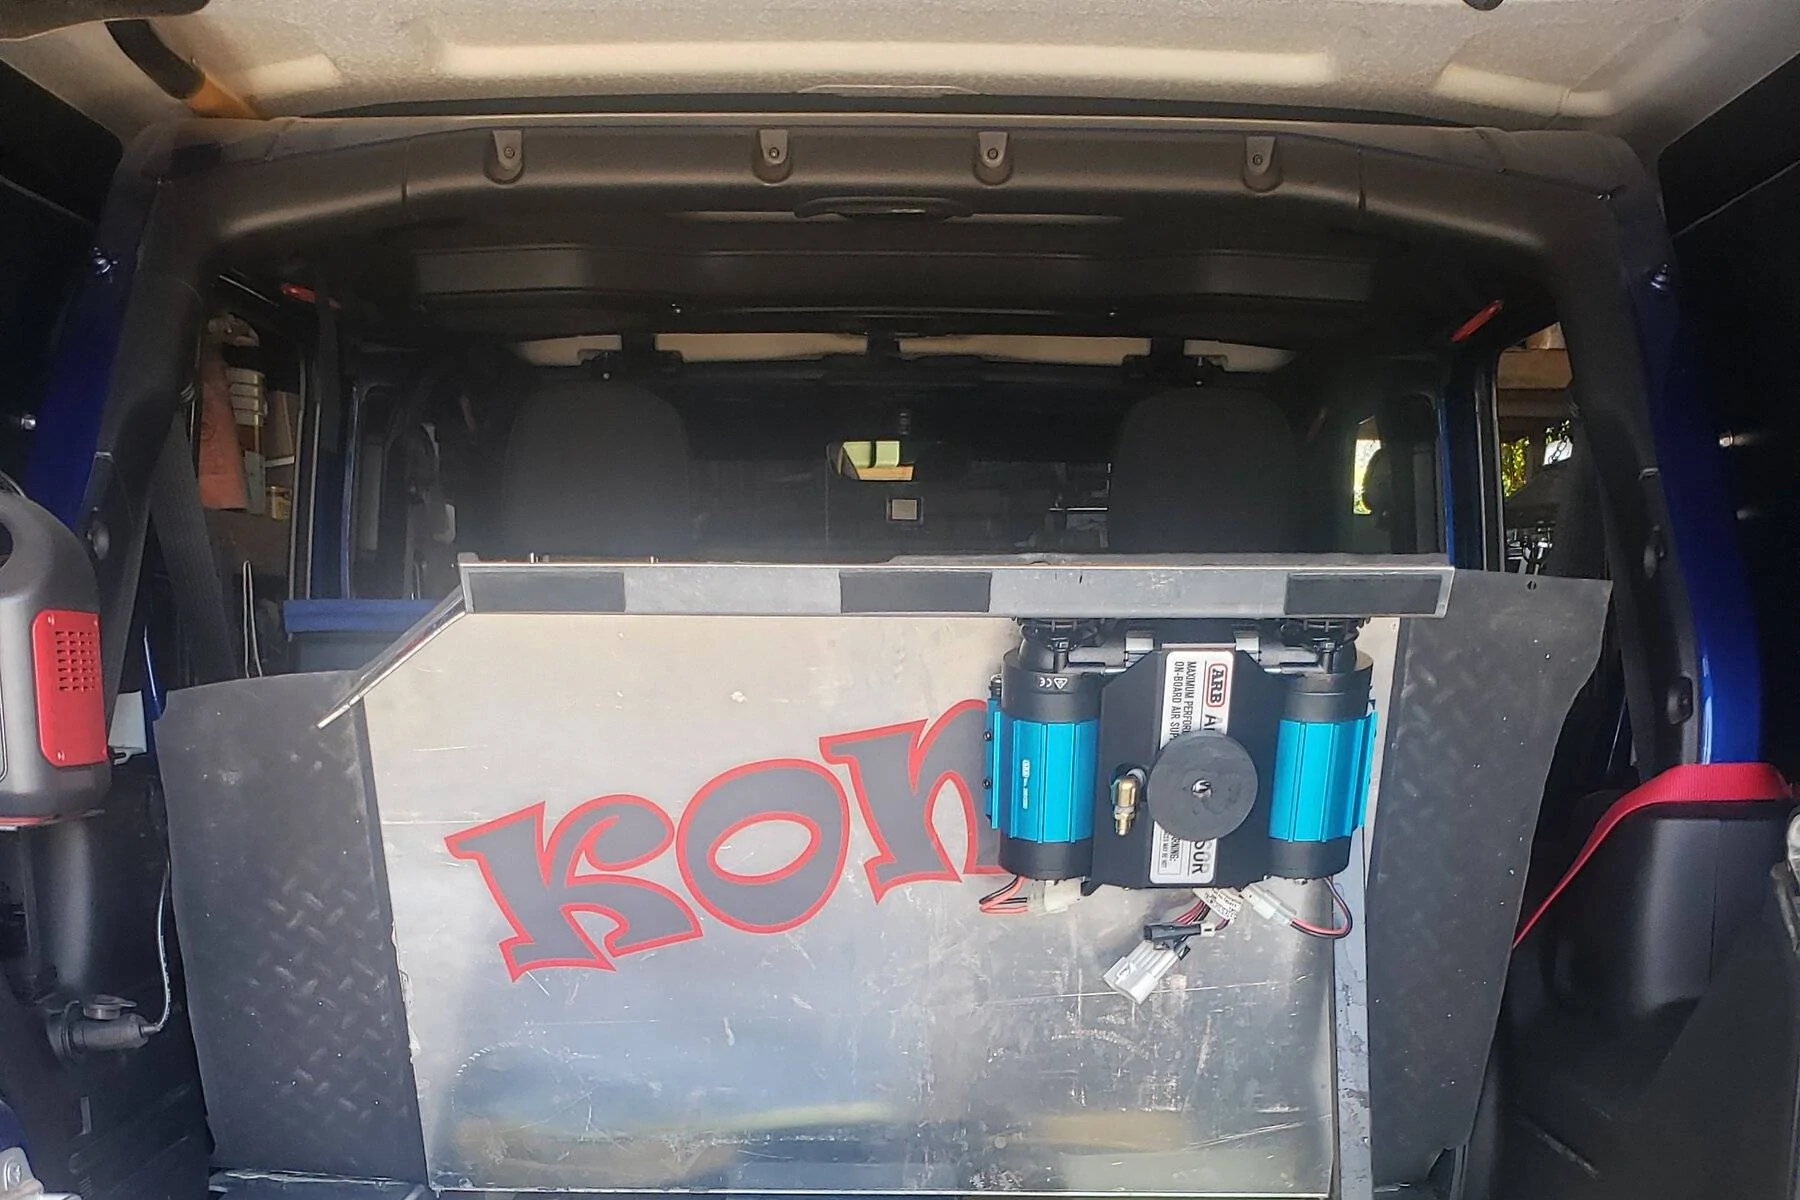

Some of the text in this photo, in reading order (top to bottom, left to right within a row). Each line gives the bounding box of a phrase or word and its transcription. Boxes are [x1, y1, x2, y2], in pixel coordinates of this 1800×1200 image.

[1169, 661, 1184, 739] ON-BOARD AIR SUP
[1182, 661, 1197, 733] MAXIMUM PERFOR
[1204, 668, 1224, 731] ARB AI
[1169, 835, 1181, 862] RNING:
[1192, 840, 1213, 875] SOR
